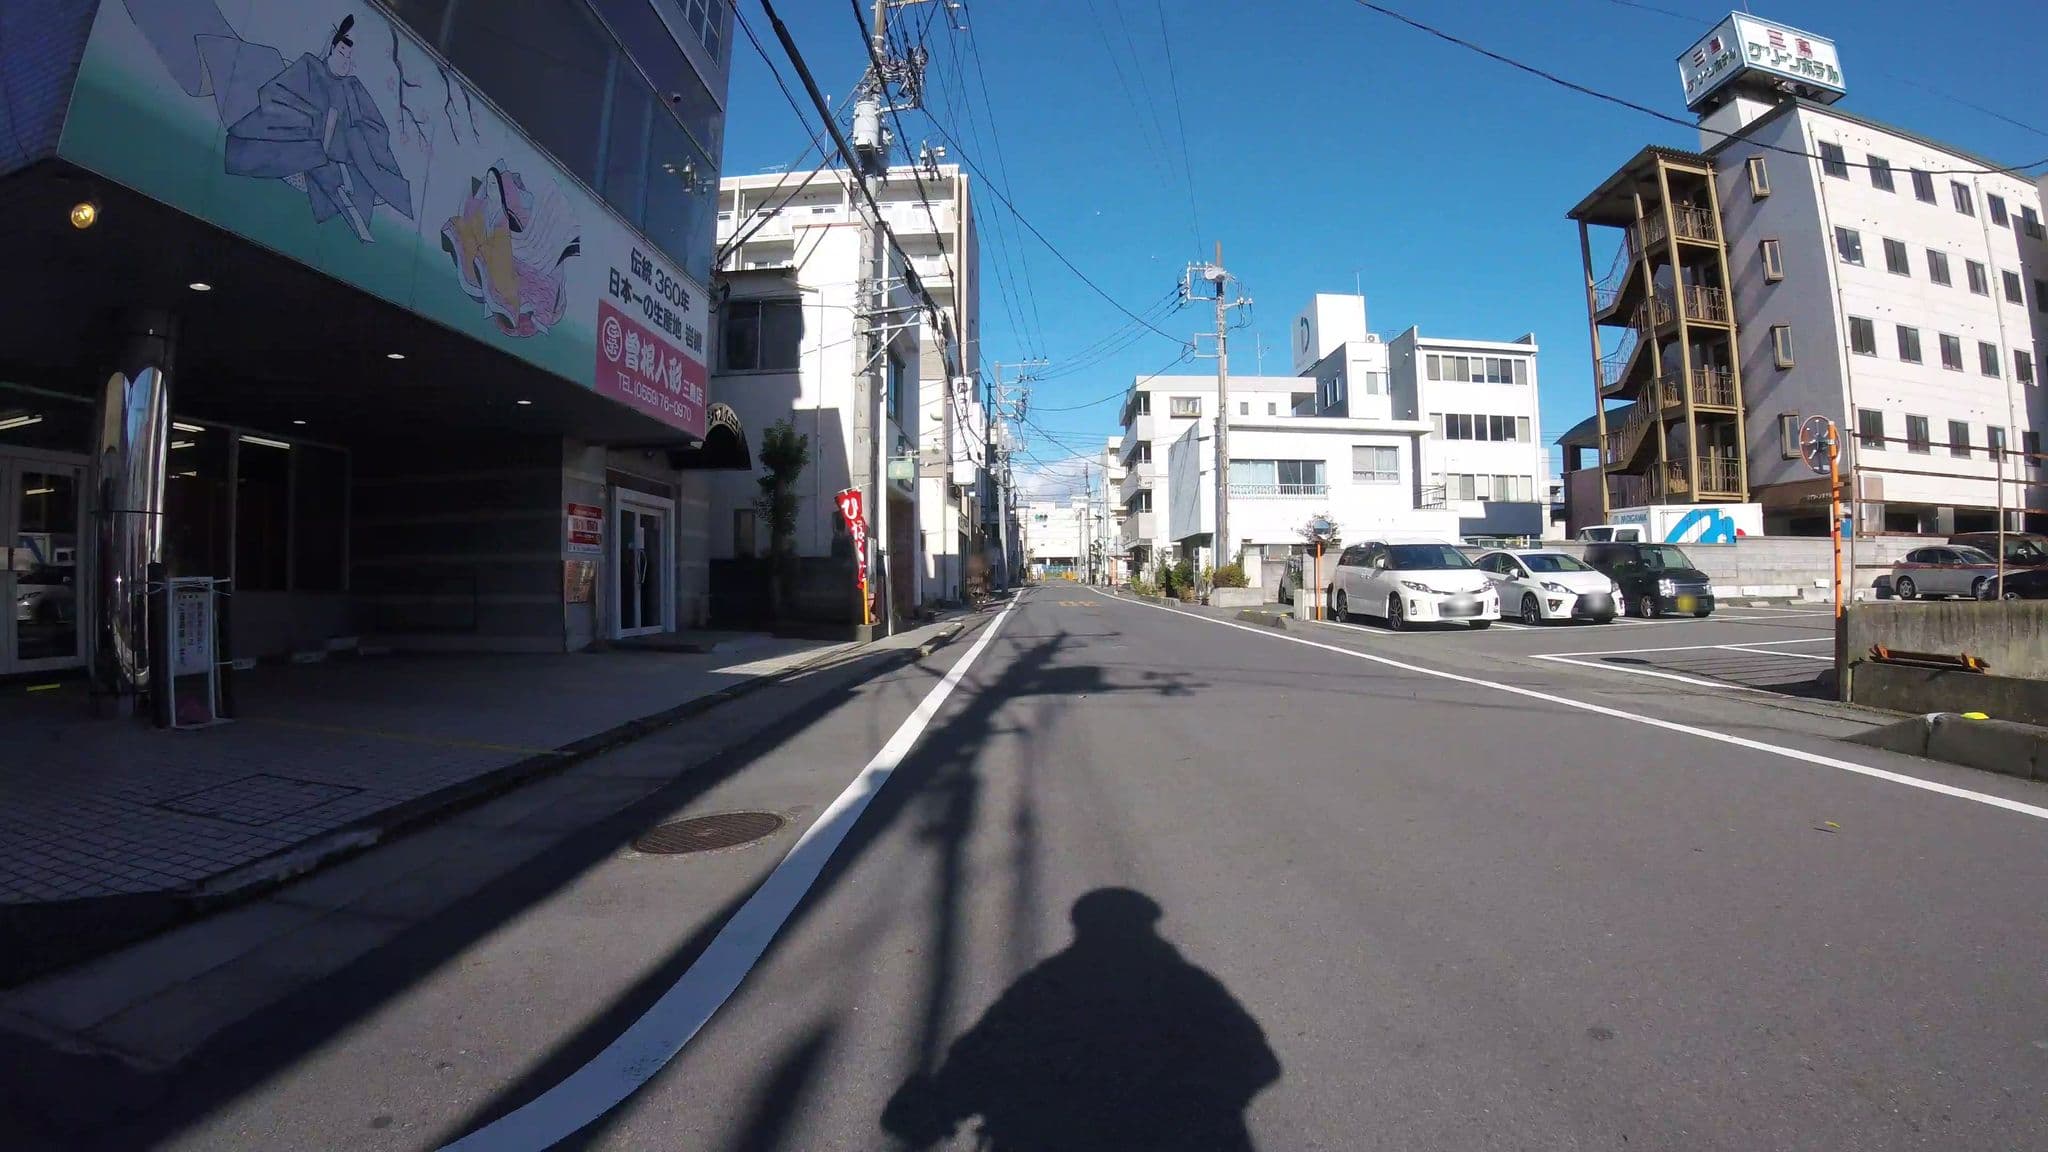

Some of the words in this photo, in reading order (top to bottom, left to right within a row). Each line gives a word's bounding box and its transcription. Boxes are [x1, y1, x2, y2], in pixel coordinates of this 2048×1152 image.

[1748, 42, 1840, 84] グリーンホテル
[608, 267, 682, 341] 日本一の生産地
[630, 247, 653, 286] 伝統
[654, 269, 690, 313] 360年
